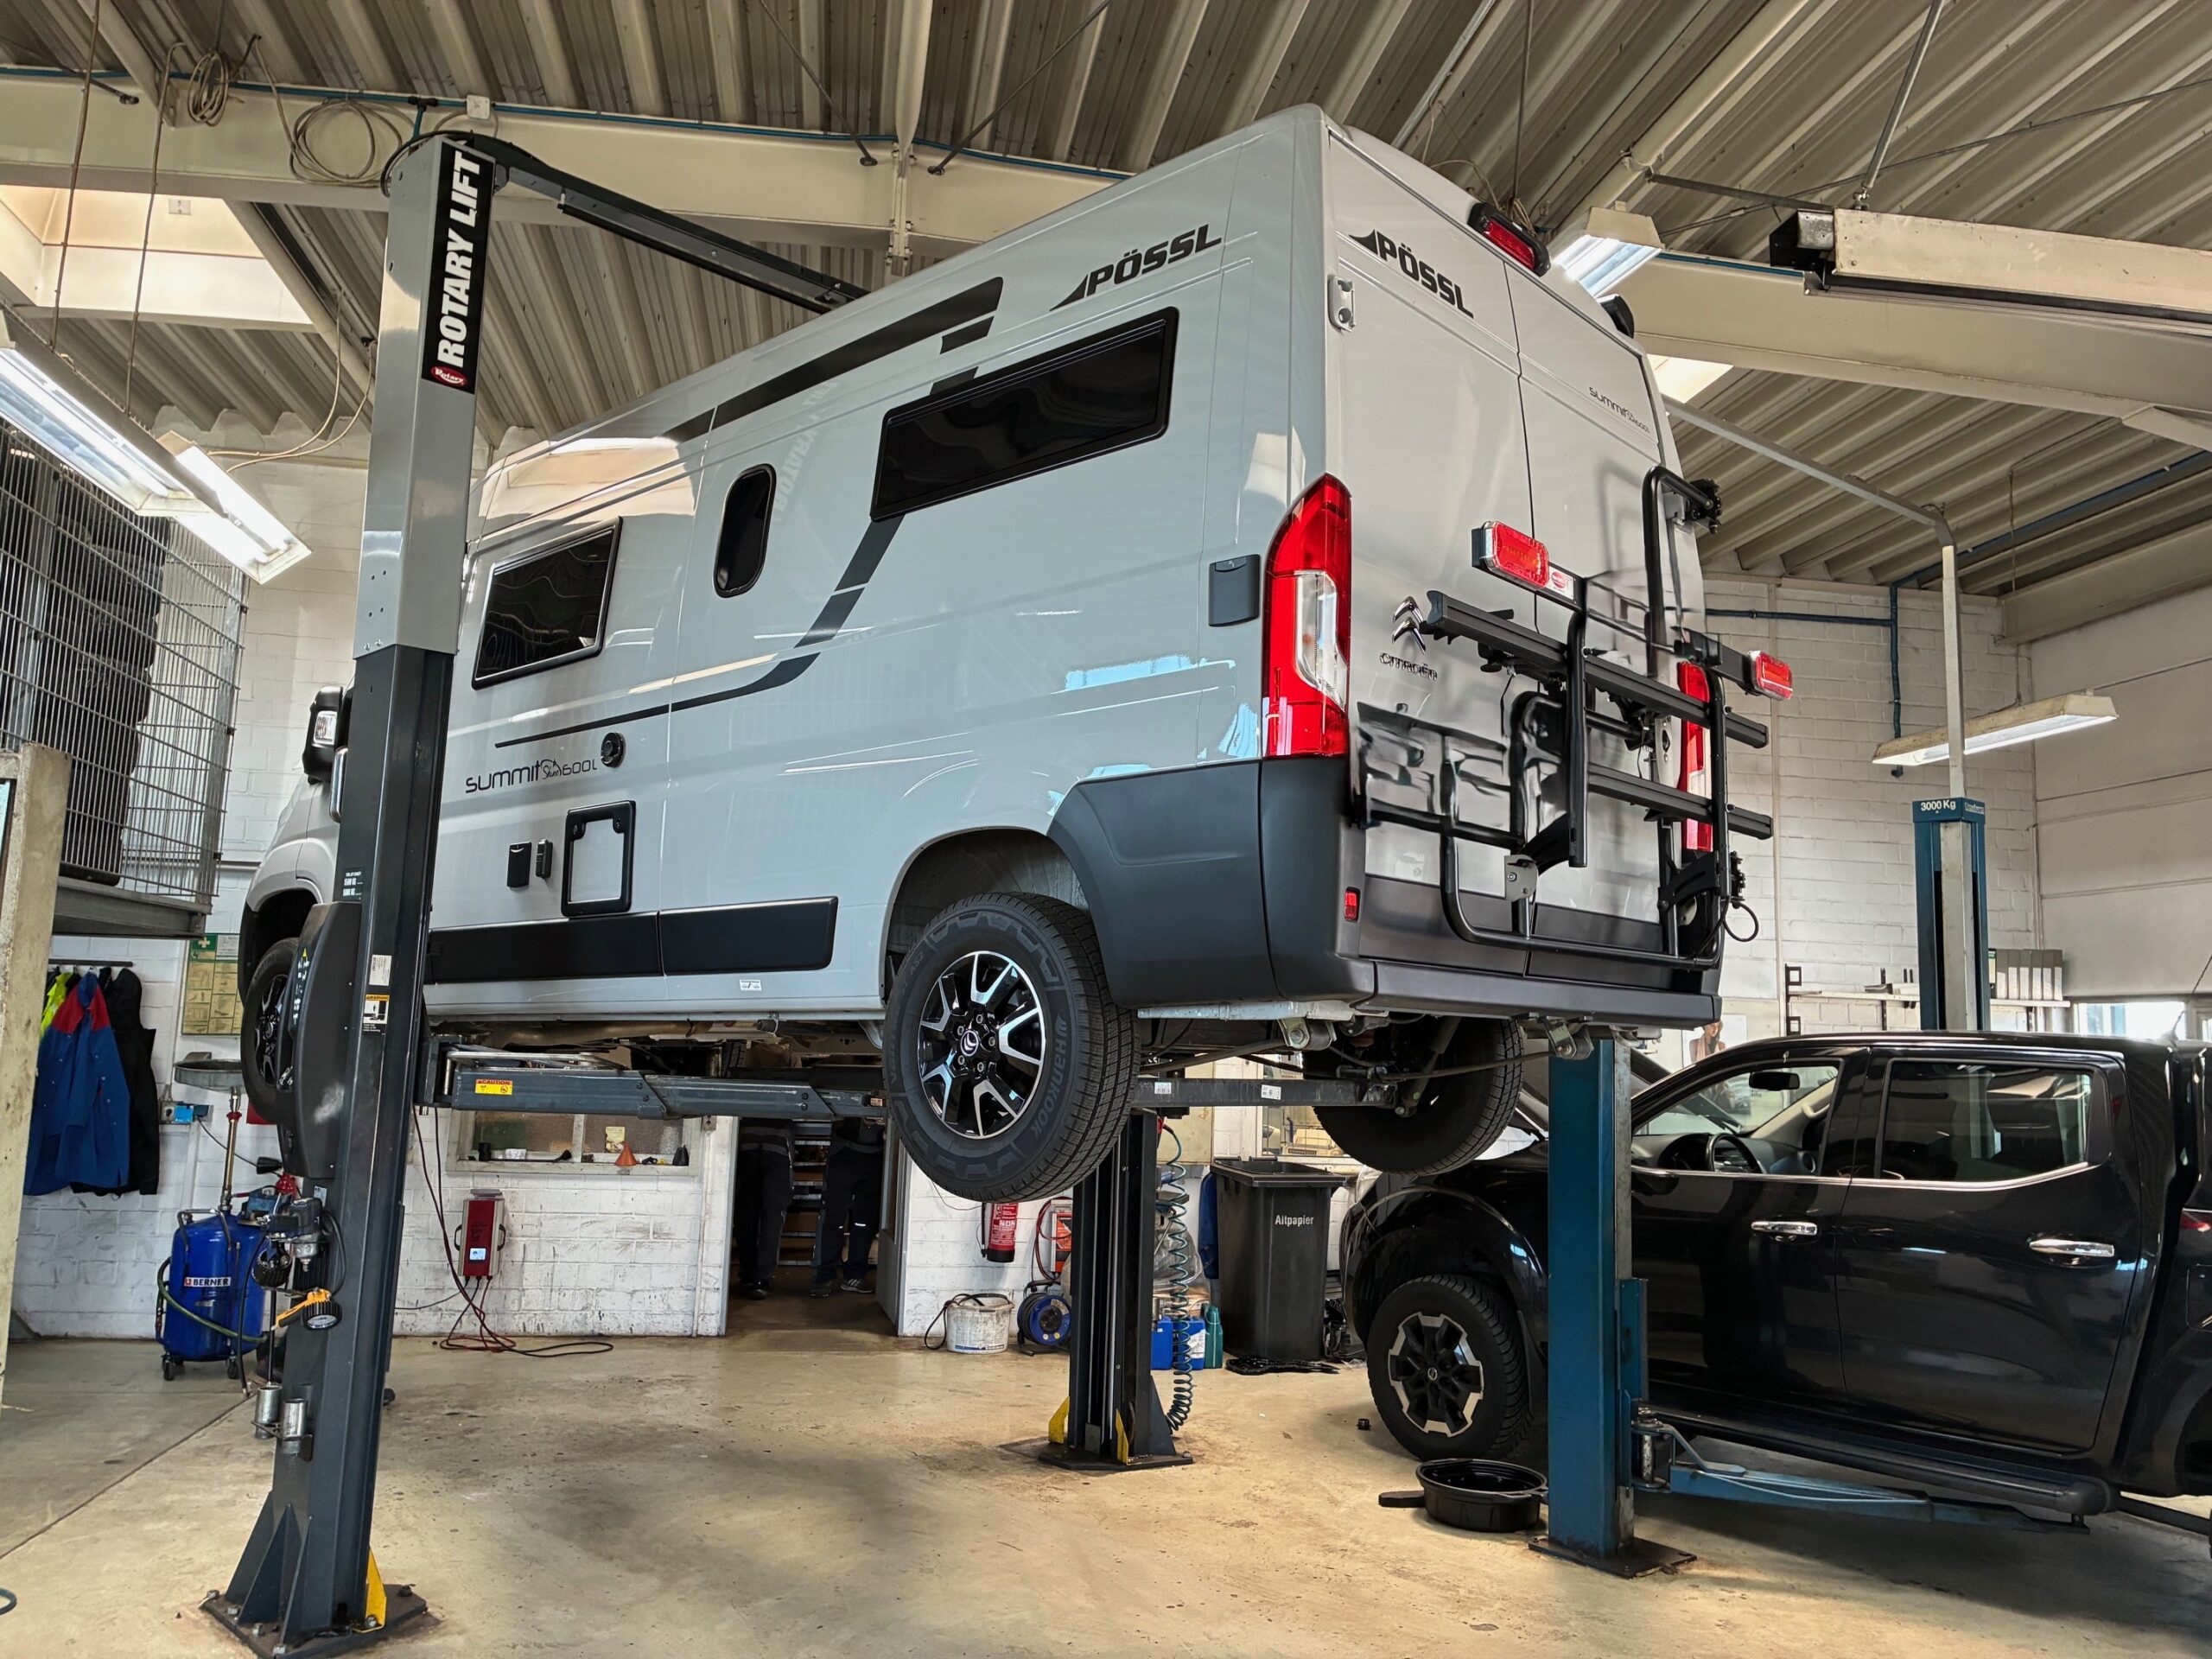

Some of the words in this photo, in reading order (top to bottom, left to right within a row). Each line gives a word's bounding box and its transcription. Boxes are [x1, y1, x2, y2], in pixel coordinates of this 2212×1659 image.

[449, 150, 480, 227] LIFT
[1086, 224, 1223, 296] PÖSSL
[1376, 231, 1474, 319] PÖSSL
[437, 228, 474, 368] ROTARY
[435, 366, 464, 382] Rotary
[1920, 800, 1942, 811] 3000
[1942, 799, 1957, 810] Kg
[1030, 1040, 1067, 1137] Hankook
[1274, 1214, 1314, 1227] Altpapier
